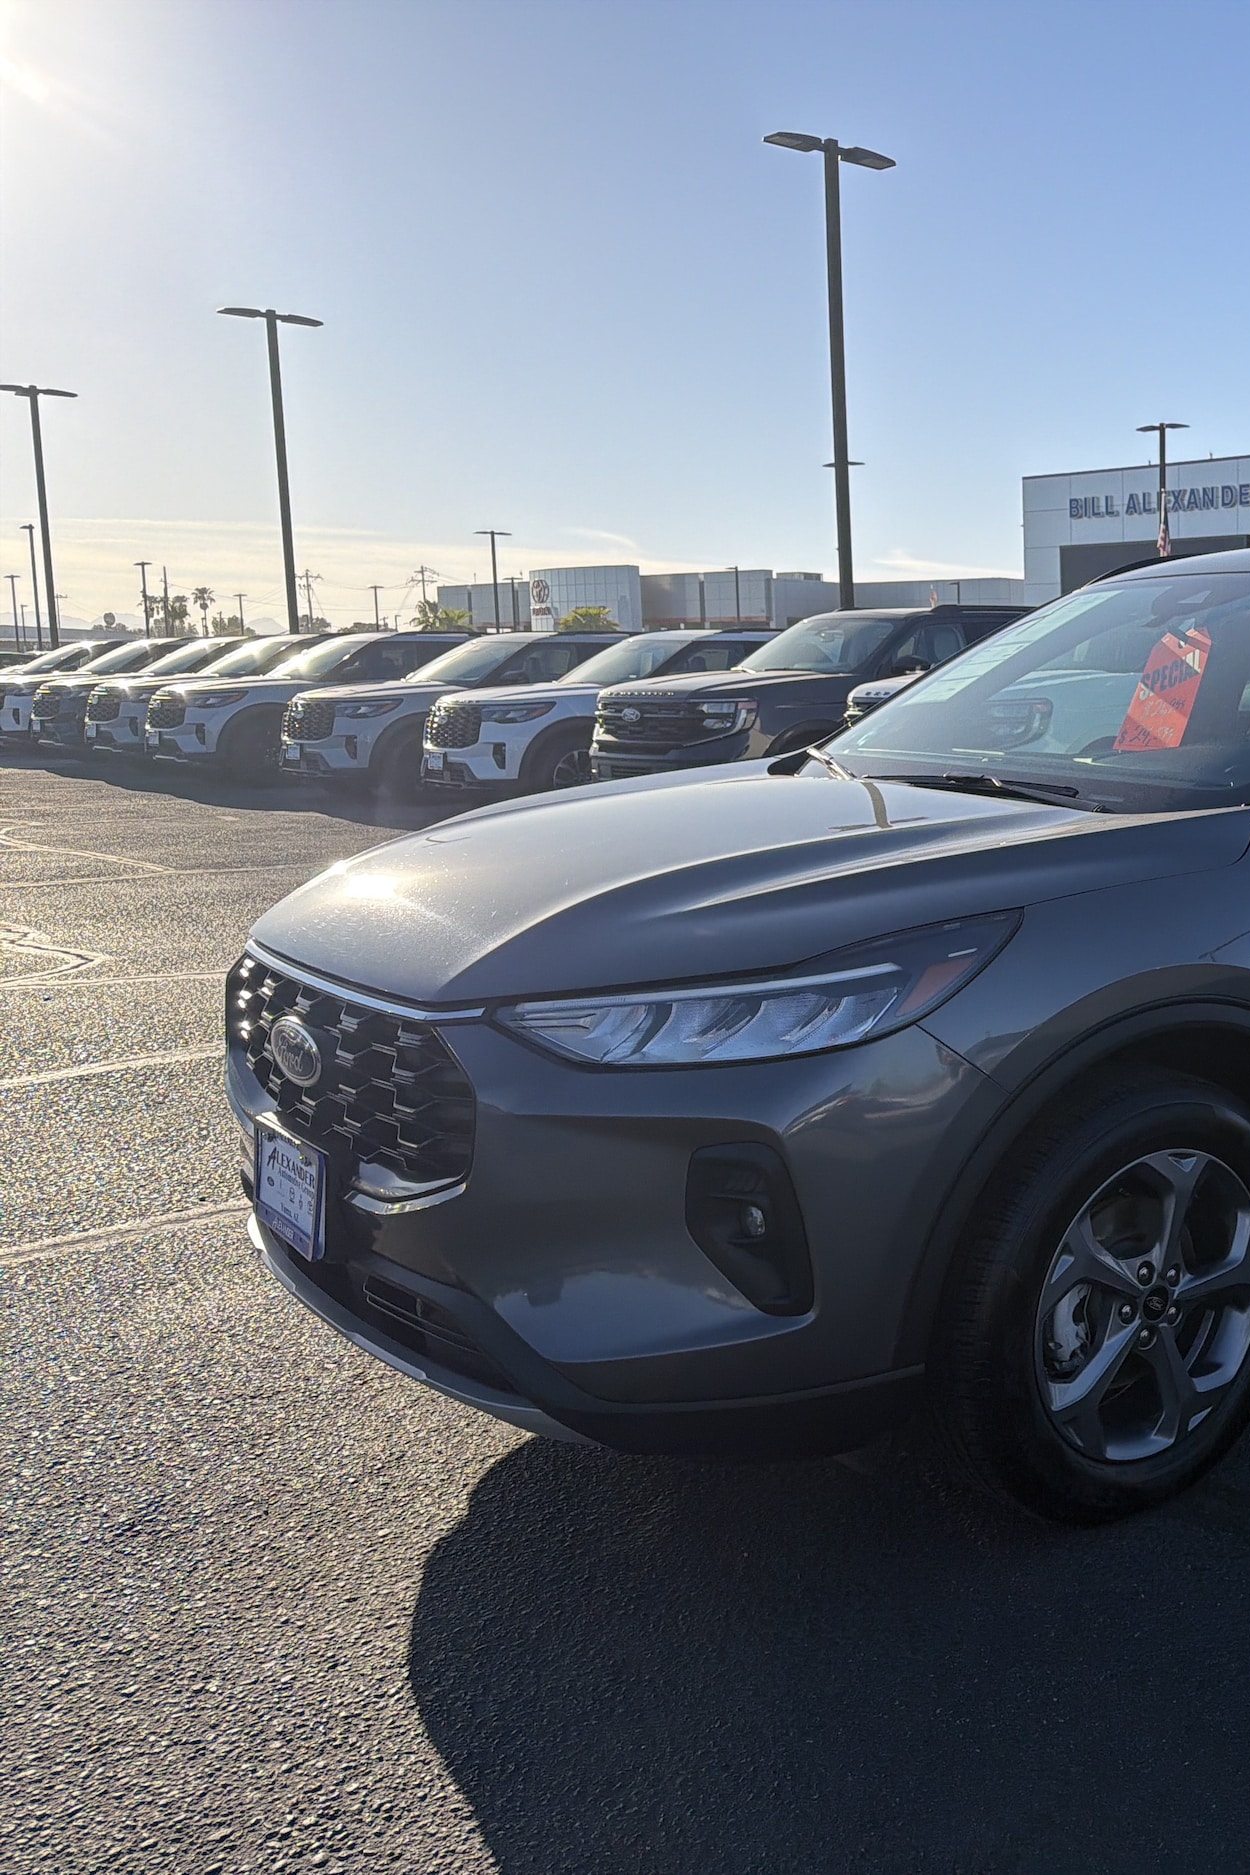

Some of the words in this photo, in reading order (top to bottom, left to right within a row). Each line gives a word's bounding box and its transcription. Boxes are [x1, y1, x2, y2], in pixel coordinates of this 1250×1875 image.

[1069, 495, 1118, 518] BILL
[1139, 648, 1201, 701] SPECIAL
[276, 1032, 304, 1072] Ford
[267, 1146, 315, 1190] ALEXANDER
